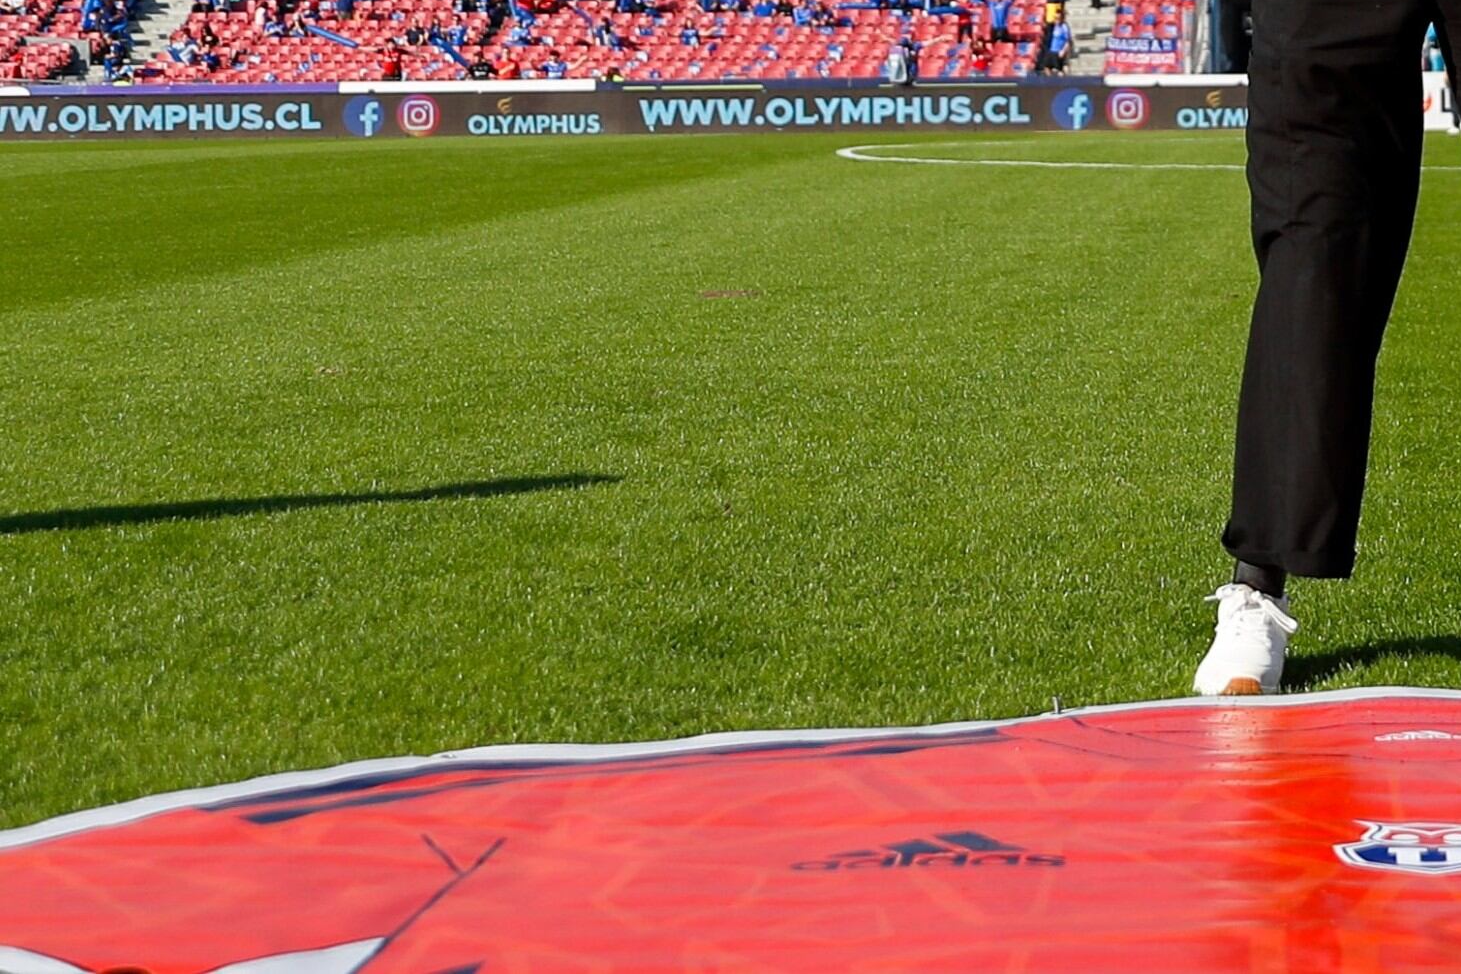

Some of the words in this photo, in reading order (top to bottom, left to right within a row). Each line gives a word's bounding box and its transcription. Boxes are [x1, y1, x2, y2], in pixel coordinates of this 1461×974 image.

[638, 96, 1031, 127] WWW.OLYMPHUS.CL
[1176, 108, 1248, 128] OLYM
[468, 114, 600, 134] OLYMPHUS
